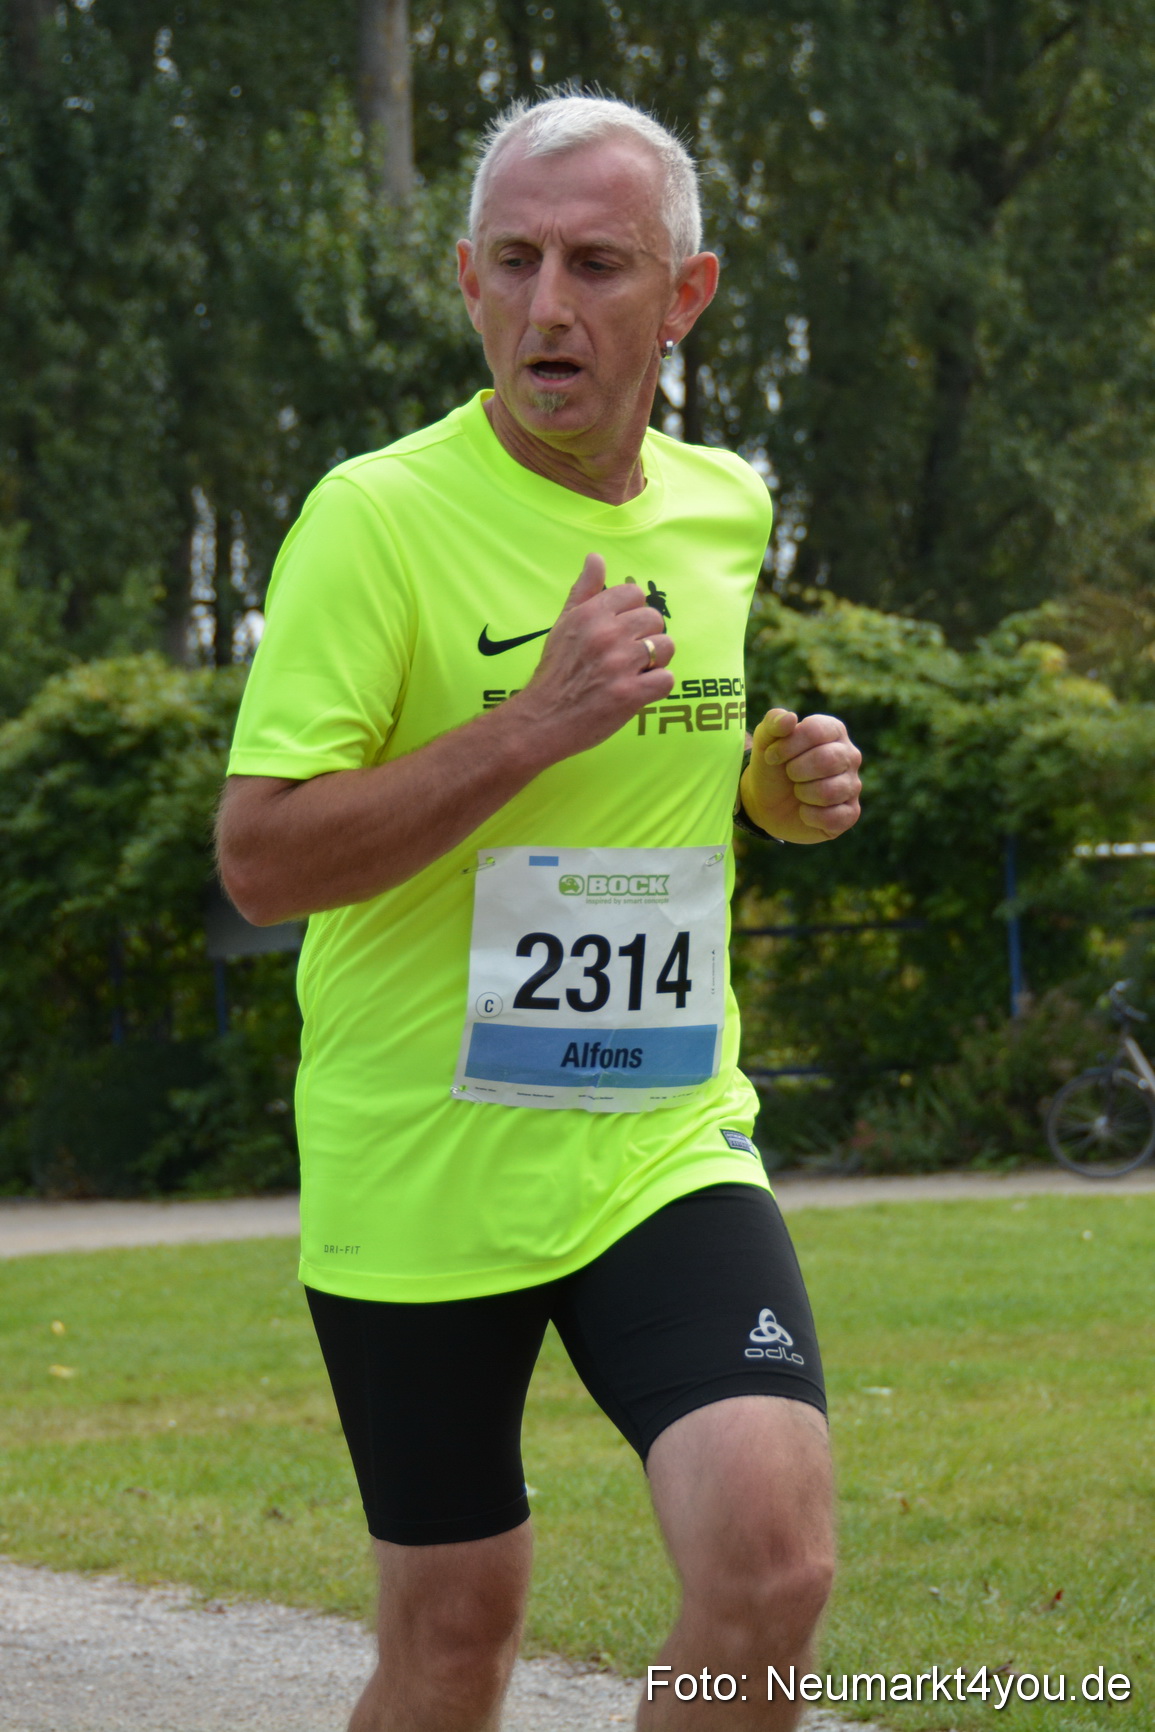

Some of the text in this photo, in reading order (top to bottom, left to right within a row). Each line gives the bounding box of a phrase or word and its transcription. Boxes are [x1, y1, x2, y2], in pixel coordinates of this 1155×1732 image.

[586, 874, 670, 896] BOCK
[586, 897, 611, 905] inspired
[614, 897, 621, 905] by
[512, 931, 692, 1012] 2314
[484, 999, 495, 1013] C
[560, 1041, 643, 1068] Alfons
[324, 1244, 361, 1254] DRI-FIT
[744, 1346, 805, 1365] odlo
